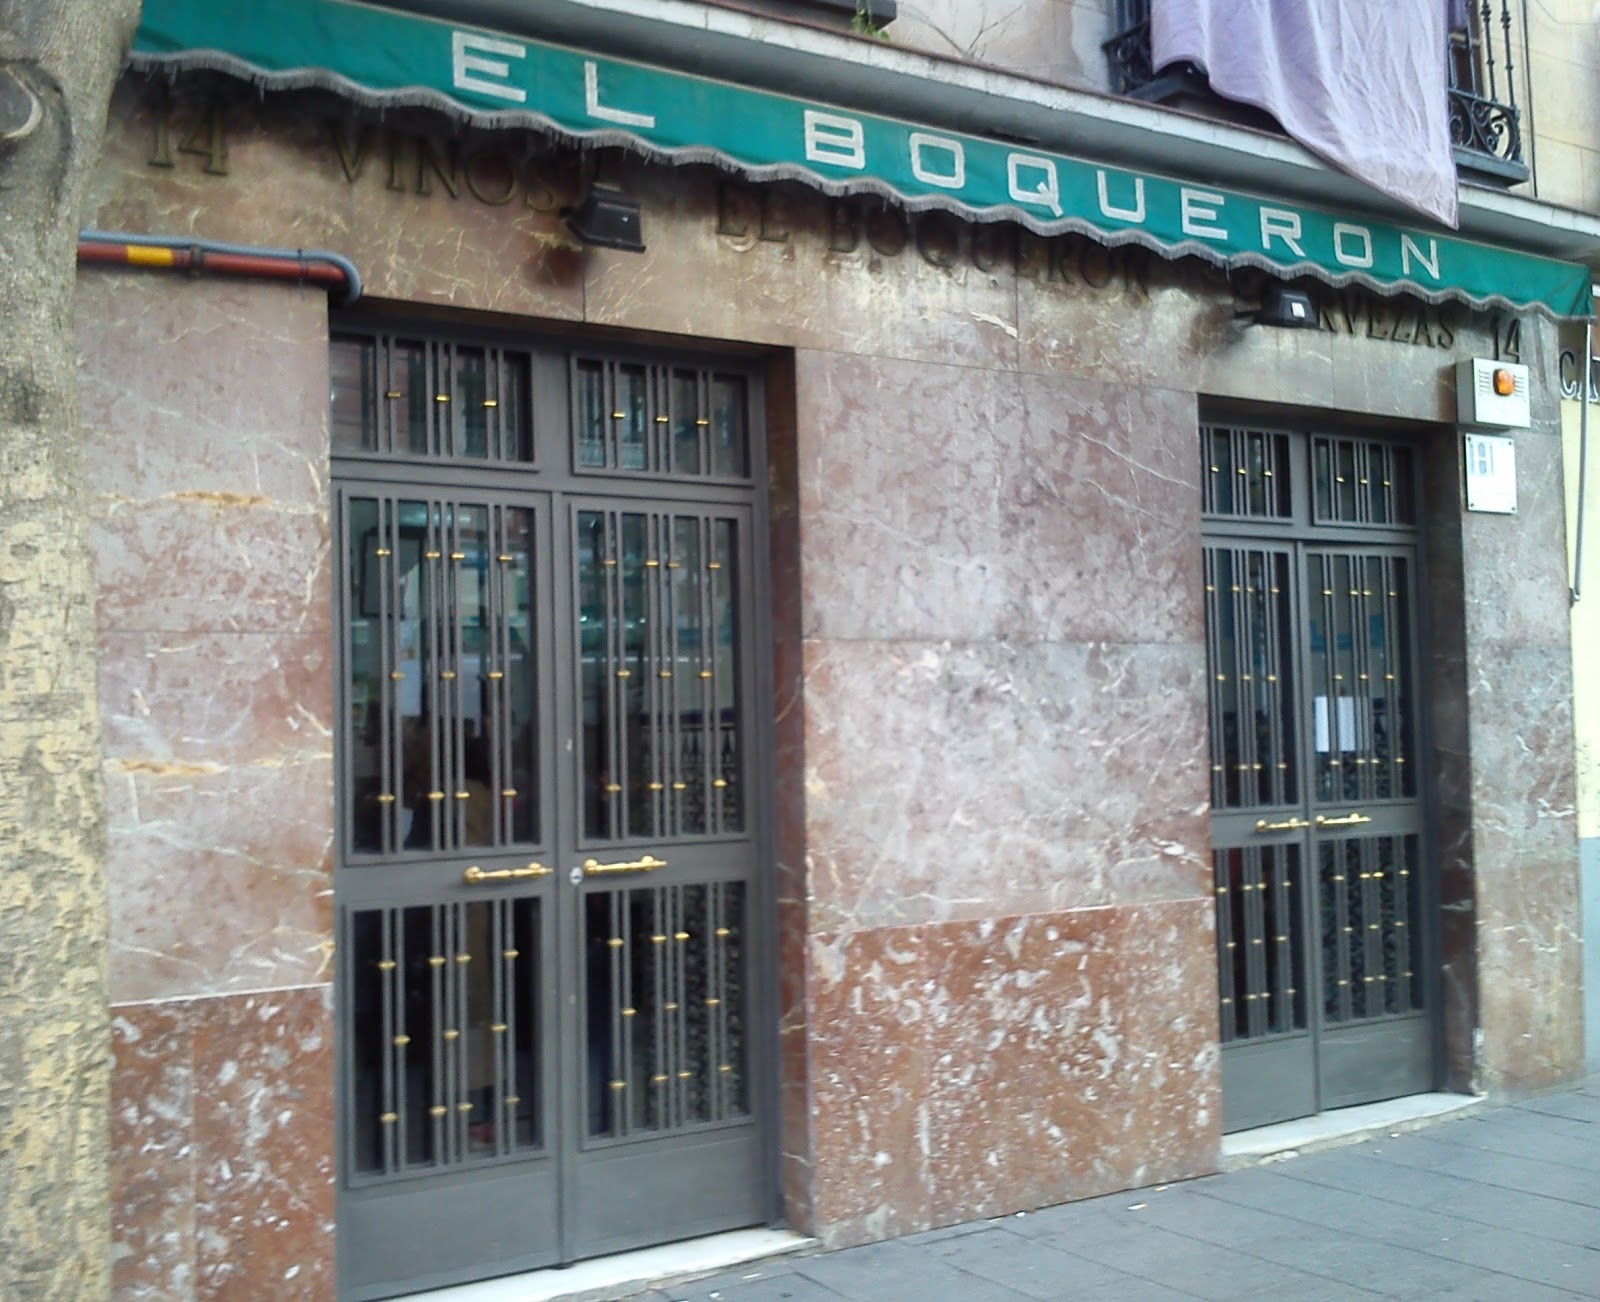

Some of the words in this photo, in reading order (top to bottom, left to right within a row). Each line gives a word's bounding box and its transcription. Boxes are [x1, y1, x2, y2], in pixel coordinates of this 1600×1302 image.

[148, 90, 229, 175] 14
[328, 118, 562, 212] VINOS
[716, 182, 790, 242] EL
[828, 196, 1150, 294] BOQUERON
[1314, 290, 1455, 350] RVEZAS
[1489, 312, 1521, 365] 14
[452, 31, 655, 128] EL
[804, 110, 1440, 280] BOQUERON
